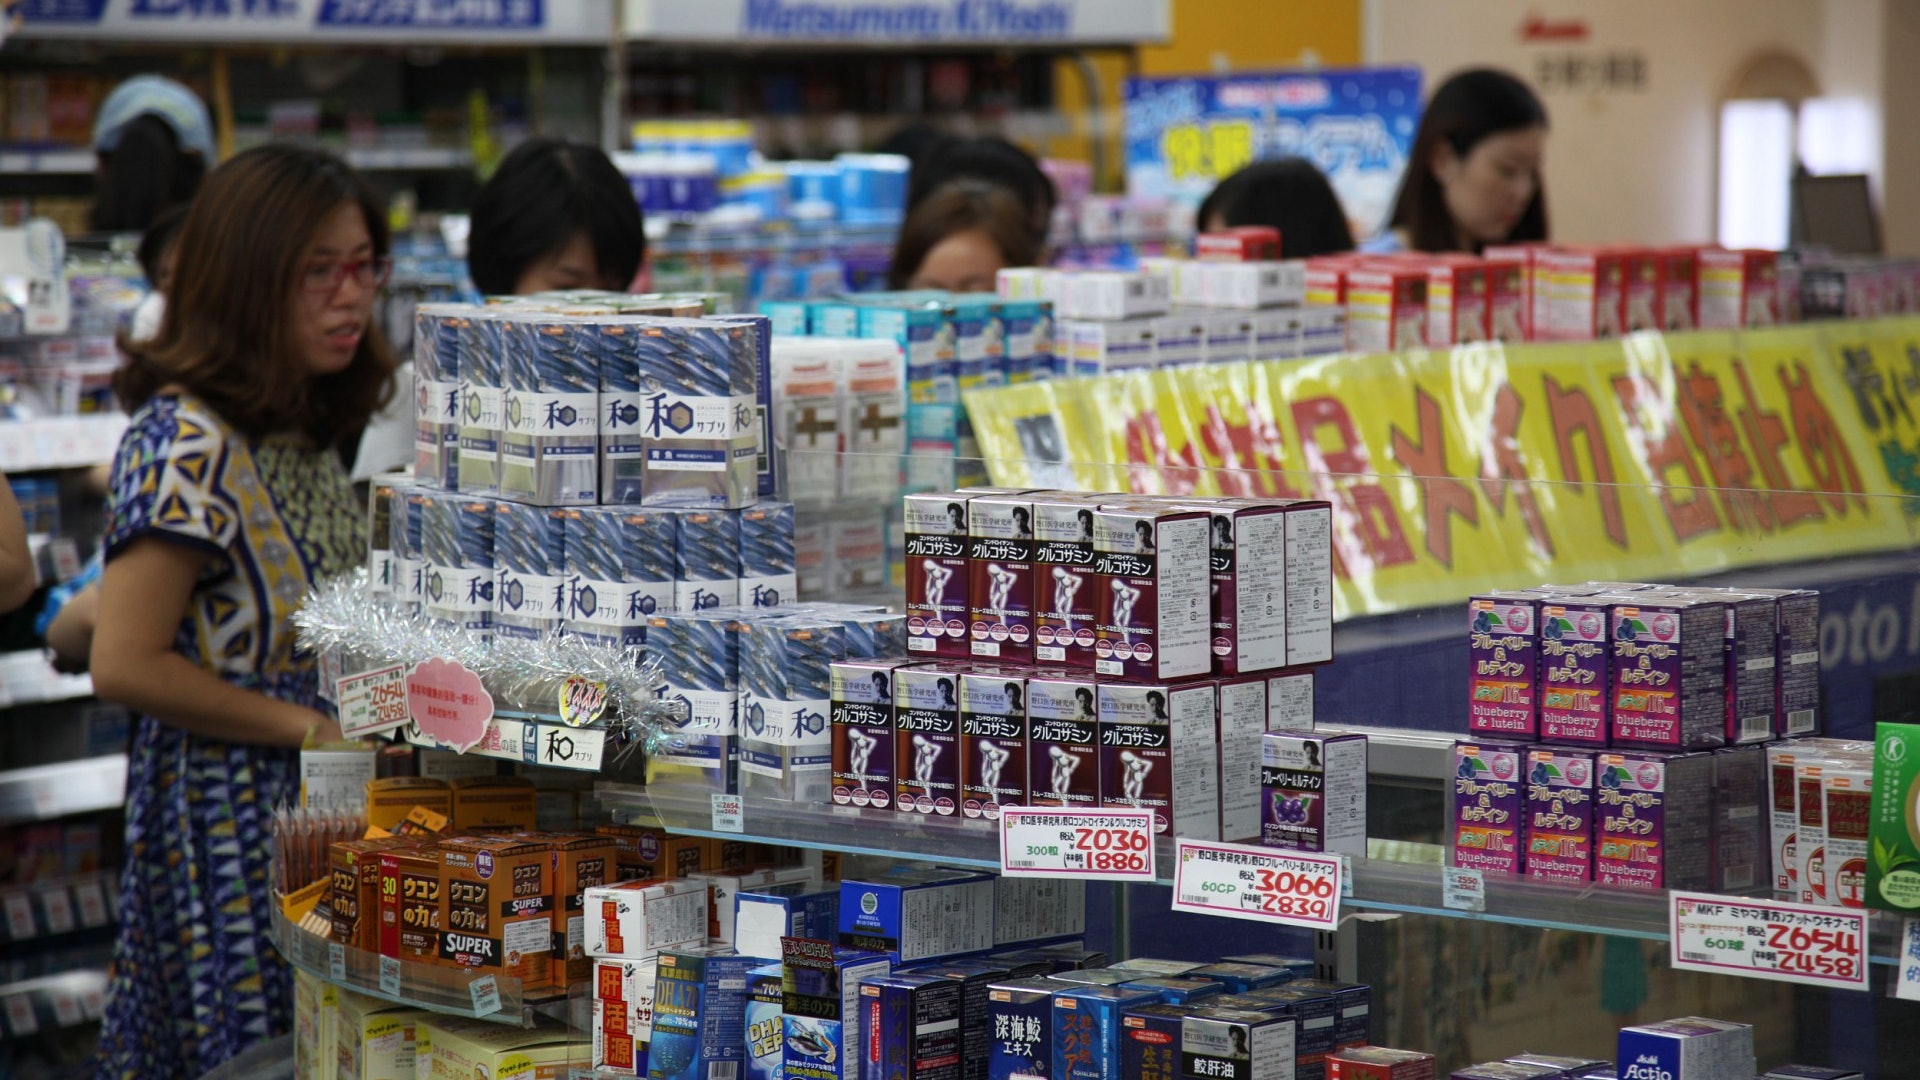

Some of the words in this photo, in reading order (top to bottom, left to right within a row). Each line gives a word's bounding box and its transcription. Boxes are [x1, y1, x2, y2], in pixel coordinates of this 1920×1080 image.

[543, 400, 577, 429] 和
[645, 392, 694, 438] 和
[907, 541, 963, 556] グルコサミン
[972, 544, 1028, 560] グルコサミン
[1037, 547, 1094, 563] グルコサミン
[1096, 558, 1152, 576] グルコサミン
[496, 568, 523, 613] 和
[567, 575, 597, 620] 和
[626, 589, 656, 620] 和
[1471, 634, 1532, 651] ブルーベリー
[1543, 640, 1603, 658] ブルーベリー
[1615, 641, 1678, 659] ブルーベリー
[1494, 647, 1506, 661] &
[1565, 653, 1578, 668] &
[1639, 656, 1651, 669] &
[1477, 660, 1525, 677] ルテイン
[1548, 667, 1596, 684] ルテイン
[1621, 668, 1670, 685] ルテイン
[741, 690, 764, 739] 和
[833, 708, 888, 725] グルコサミン
[1473, 705, 1529, 720] blueberry
[1544, 712, 1600, 728] blueberry
[792, 707, 825, 739] 和
[898, 715, 953, 732] グルコサミン
[964, 720, 1021, 737] グルコサミン
[1478, 717, 1487, 727] &
[1491, 718, 1525, 730] lutein
[1548, 724, 1558, 735] &
[1562, 725, 1596, 738] lutein
[1616, 714, 1674, 731] blueberry
[1033, 725, 1092, 743] グルコサミン
[1103, 730, 1165, 747] グルコサミン
[1621, 726, 1630, 736] &
[1635, 727, 1670, 740] lutein
[544, 729, 575, 763] 和
[1262, 770, 1321, 789] ブルーベリー&ルテイン
[1456, 779, 1516, 798] ブルーベリー
[1529, 785, 1589, 804] ブルーベリー
[1479, 793, 1490, 808] &
[1552, 800, 1563, 814] &
[1599, 789, 1661, 808] ブルーベリー
[1461, 806, 1509, 824] ルテイン
[1622, 803, 1635, 818] &
[1534, 812, 1582, 830] ルテイン
[1604, 816, 1654, 834] ルテイン
[1060, 832, 1075, 841] 税込
[1026, 845, 1059, 856] 300粒
[1457, 851, 1512, 868] blueberry
[1529, 858, 1585, 875] blueberry
[514, 866, 540, 879] ウコン
[1239, 870, 1255, 881] 税込
[1599, 862, 1657, 879] blueberry
[333, 871, 355, 892] ウコン
[382, 876, 396, 895] 30
[403, 877, 440, 900] ウコン
[514, 881, 532, 895] の力
[1201, 881, 1236, 894] 60CP
[450, 881, 487, 903] ウコン
[333, 895, 349, 916] の力
[512, 897, 543, 911] SUPER
[1697, 904, 1724, 916] MKF
[403, 904, 430, 928] の力
[450, 907, 475, 929] の力
[1747, 925, 1766, 937] 税込
[446, 933, 493, 957] SUPER
[1704, 938, 1745, 951] 60球
[786, 995, 836, 1017] 海洋の力
[601, 968, 631, 1065] 肝活源
[748, 1016, 783, 1043] DHA
[995, 1012, 1043, 1044] 深海鮫
[1003, 1041, 1033, 1057] エキス
[1194, 1057, 1235, 1079] 鮫肝油
